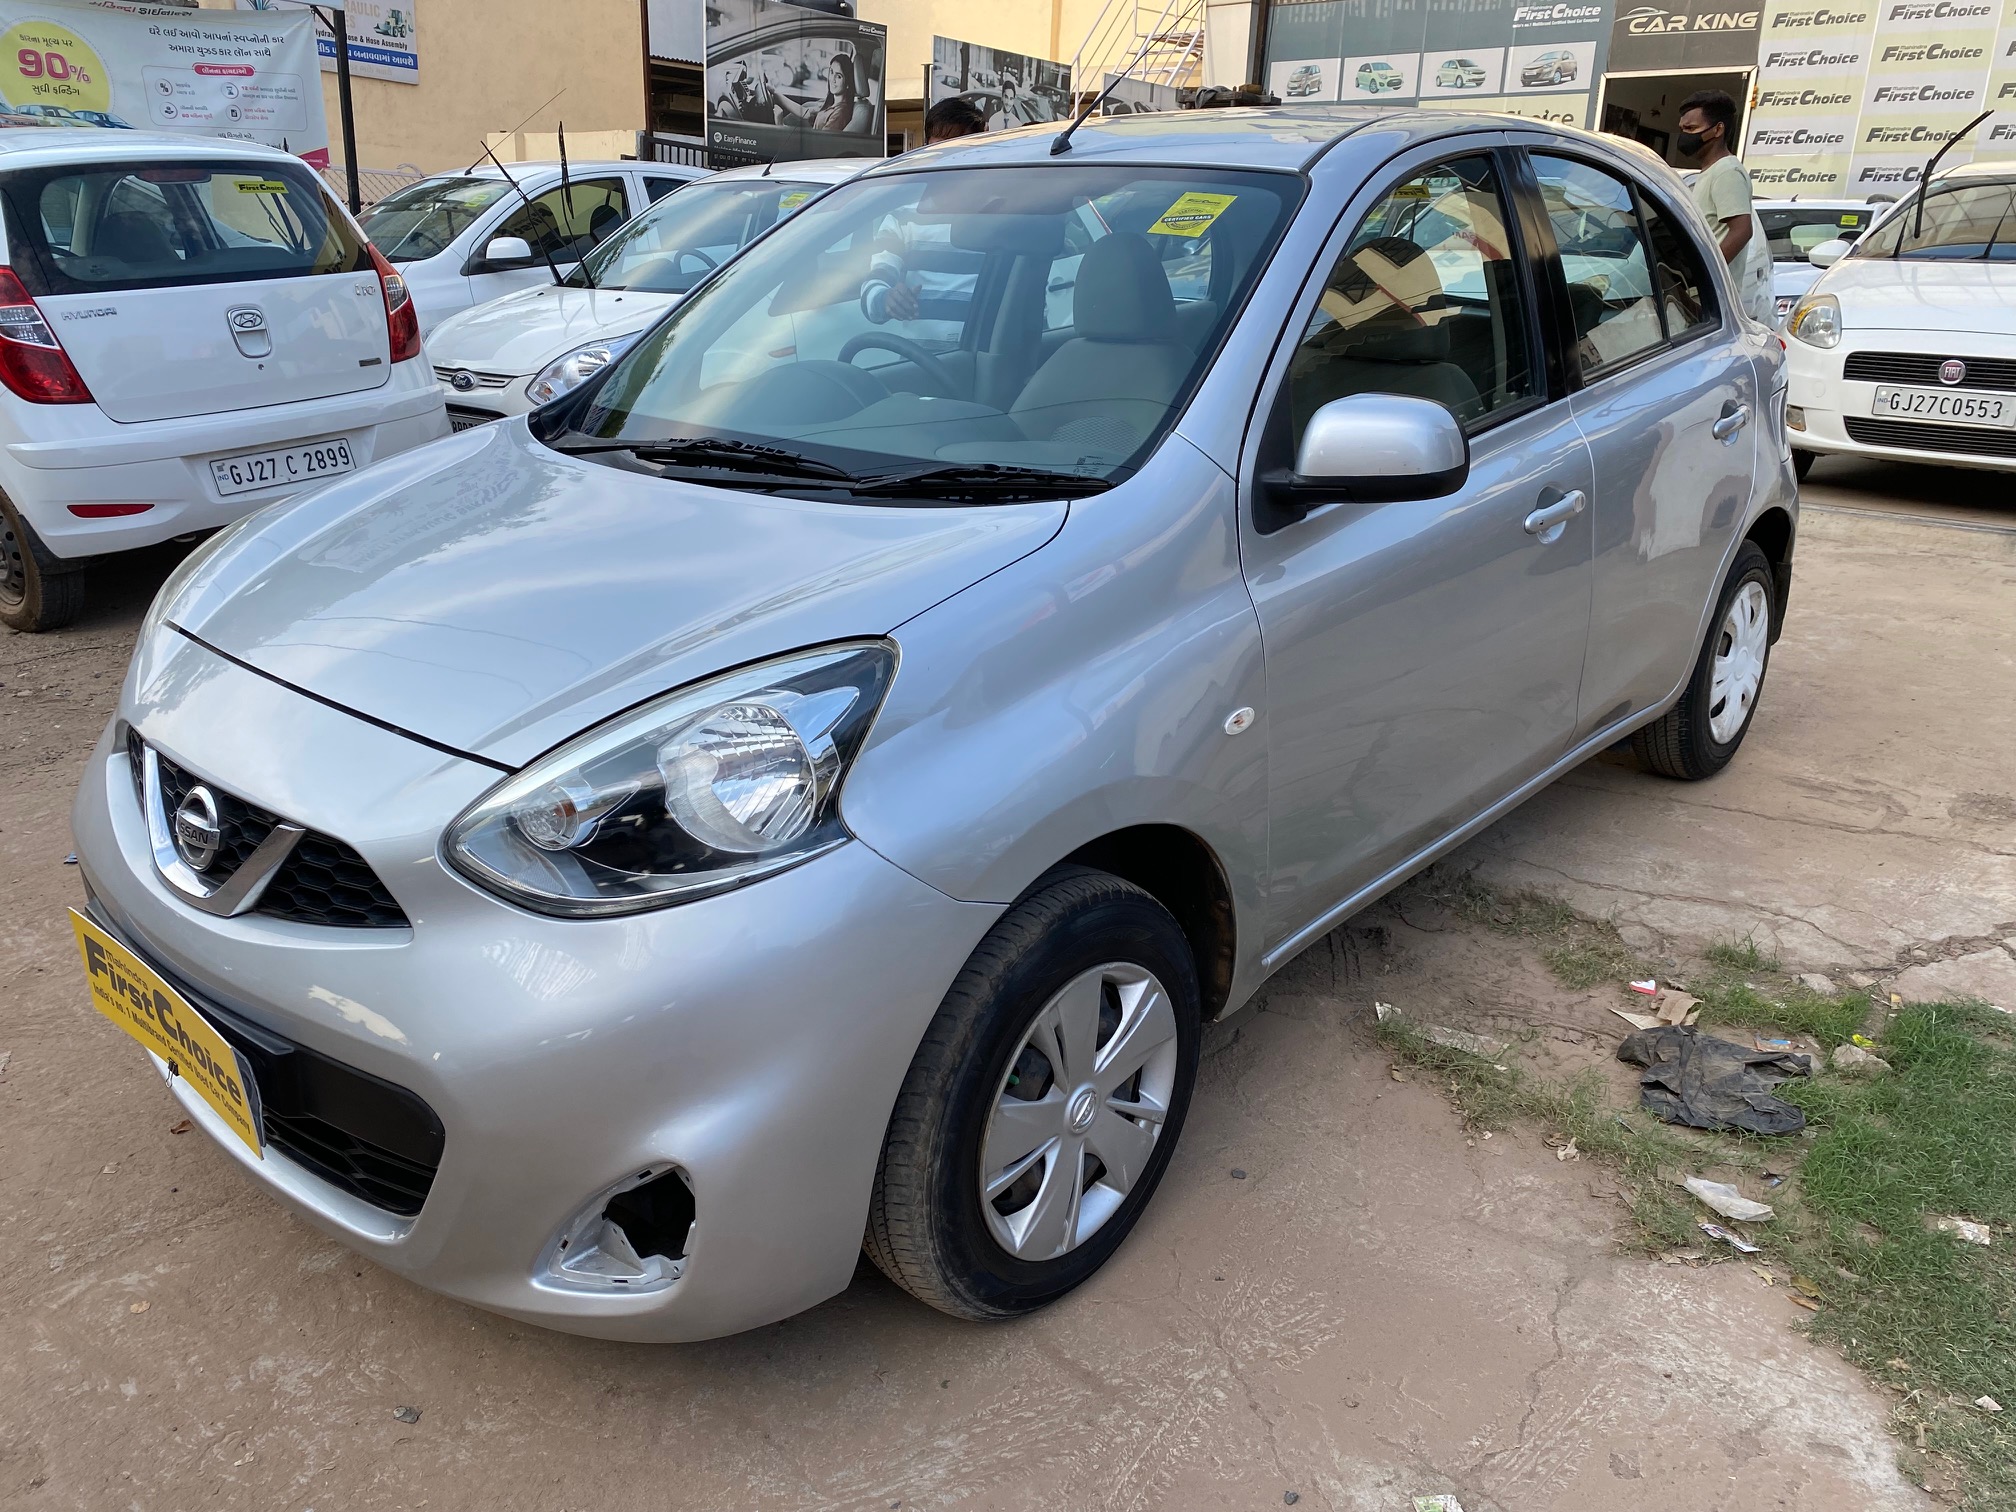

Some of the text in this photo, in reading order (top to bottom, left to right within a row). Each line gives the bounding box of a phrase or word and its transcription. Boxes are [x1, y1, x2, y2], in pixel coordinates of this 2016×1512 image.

[1513, 3, 1602, 21] FirstChoice
[1771, 9, 1867, 28] FirstChoice
[1888, 1, 1991, 21] FirstChoice
[1628, 11, 1760, 33] CAR KING
[272, 36, 285, 44] કાર
[365, 37, 380, 45] Hose
[382, 39, 408, 51] Assembly
[168, 43, 195, 53] અમારા
[218, 48, 232, 56] કાર
[1765, 49, 1859, 68] FirstChoice
[1880, 43, 1983, 62] FirstChoice
[17, 48, 92, 83] 90%
[31, 83, 50, 95] સુધી
[1758, 89, 1852, 107] FirstChoice
[1873, 84, 1975, 103] FirstChoice
[1752, 129, 1844, 145] FirstChoice
[1865, 125, 1965, 142] FirstChoic
[1749, 167, 1837, 183] FirstChoice
[1858, 166, 1923, 182] FirstCh
[61, 307, 117, 320] HYUNDAI
[1944, 366, 1961, 378] FIAT
[303, 446, 350, 472] 2899
[83, 932, 242, 1107] FirstChoice
